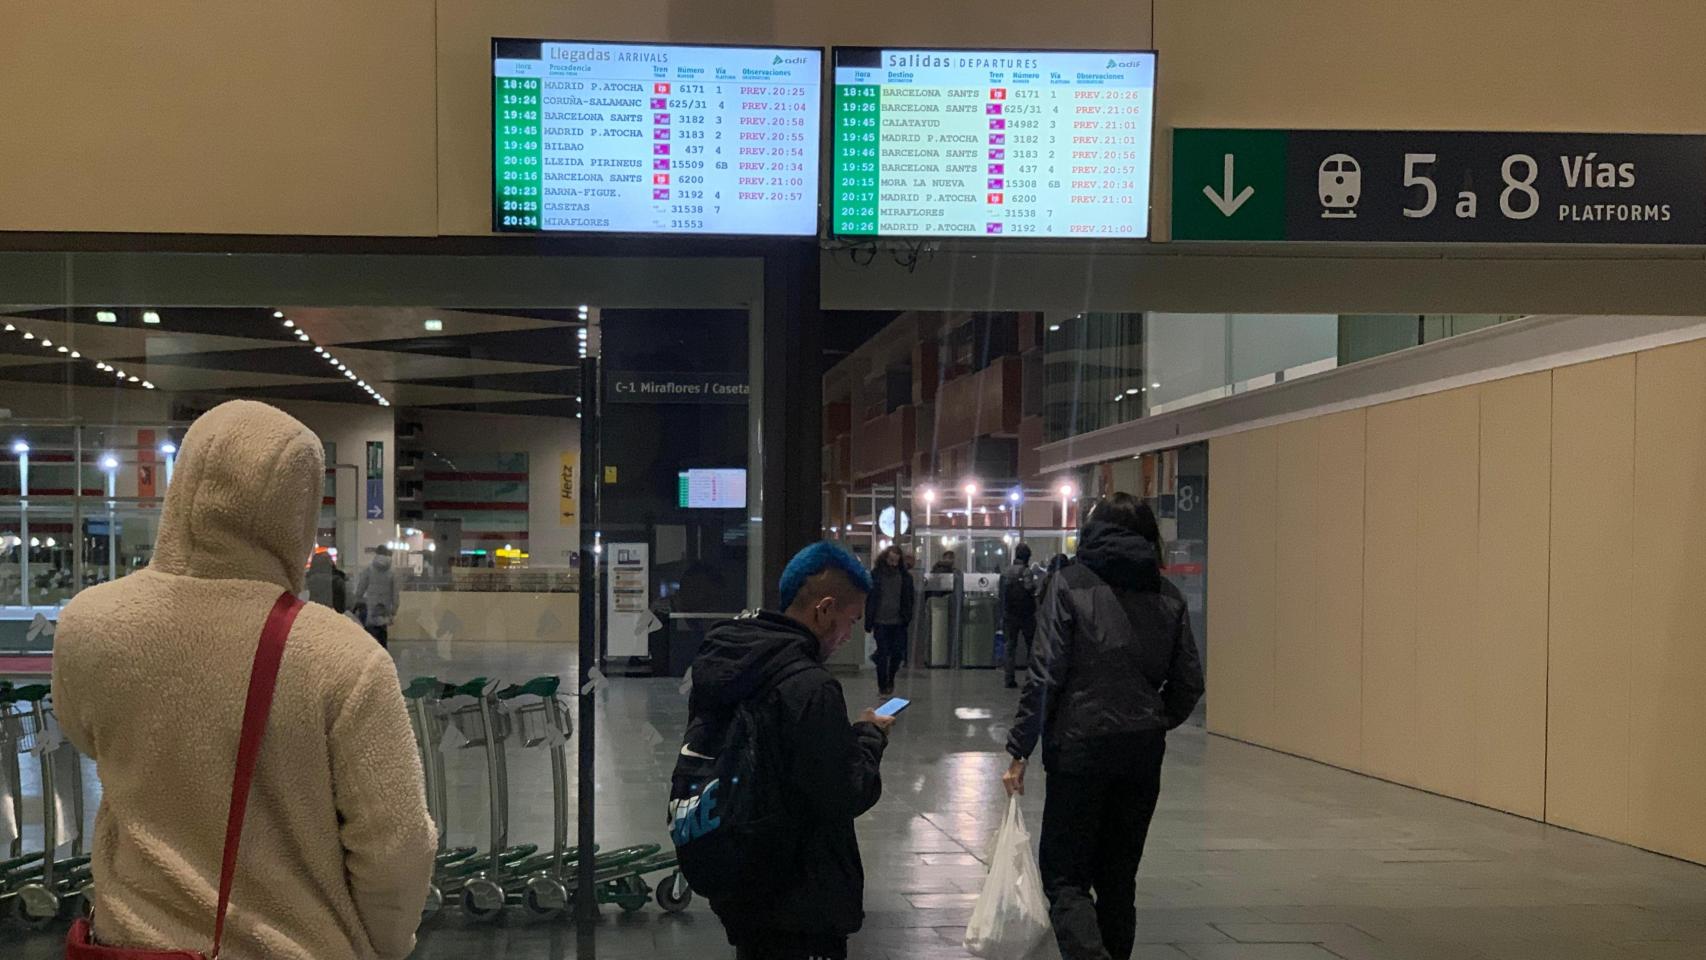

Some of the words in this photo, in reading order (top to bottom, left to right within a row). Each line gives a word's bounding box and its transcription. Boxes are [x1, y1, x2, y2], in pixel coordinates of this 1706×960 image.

[550, 48, 610, 62] Llegadas
[619, 52, 668, 62] ARRIVALS
[890, 55, 950, 67] Salidas
[960, 58, 1037, 68] DEPARTURES
[678, 66, 704, 74] Número
[742, 68, 791, 76] Observaciones
[504, 80, 537, 89] 18:40
[591, 83, 644, 92] P.ATOCHA
[680, 85, 704, 93] 6171
[717, 86, 722, 94] 1
[741, 87, 805, 96] PREV.20:25
[844, 88, 875, 96] 18:41
[883, 89, 941, 97] BARCELONA
[1075, 91, 1138, 99] PREV.20:26
[504, 96, 537, 104] 19:24
[544, 95, 642, 107] CORUÑA-SALAMANC
[669, 101, 706, 109] 625/31
[742, 103, 806, 111] PREV.21:04
[843, 103, 875, 112] 19:26
[882, 104, 939, 112] BARCELONA
[1053, 106, 1058, 114] 4
[1076, 106, 1139, 114] PREV.21:06
[504, 111, 537, 120] 19:42
[545, 112, 604, 121] BARCELONA
[610, 114, 643, 122] SANTS
[680, 116, 704, 124] 3182
[716, 116, 721, 124] 3
[740, 118, 804, 126] PREV.20:58
[843, 118, 875, 127] 19:45
[882, 119, 940, 127] CALATAYUD
[1051, 121, 1056, 129] 3
[1074, 121, 1136, 129] PREV.21:01
[504, 126, 537, 135] 19:45
[544, 128, 584, 136] MADRID
[591, 129, 643, 137] P.ATOCHA
[679, 131, 704, 139] 3183
[740, 133, 804, 141] PREV.20:55
[843, 133, 875, 142] 19:45
[882, 134, 920, 142] MADRID
[928, 135, 978, 143] P.ATOCHA
[1050, 136, 1055, 144] 3
[1073, 136, 1135, 144] PREV.21:01
[504, 142, 537, 150] 19:49
[544, 143, 584, 151] BILBAO
[685, 146, 704, 154] 437
[740, 148, 803, 156] PREV.20:54
[843, 148, 875, 157] 19:46
[882, 149, 939, 157] BARCELONA
[946, 150, 978, 158] SANTS
[1073, 151, 1135, 159] PREV.20:56
[504, 157, 537, 165] 20:05
[545, 158, 584, 166] LLEIDA
[590, 159, 642, 167] PIRINEUS
[672, 161, 704, 169] 15509
[739, 163, 803, 171] PREV.20:34
[842, 163, 874, 172] 19:52
[882, 164, 939, 172] BARCELONA
[945, 165, 977, 173] SANTS
[1072, 166, 1134, 174] PREV.20:57
[1559, 152, 1634, 188] Vías
[504, 172, 537, 180] 20:16
[544, 173, 604, 182] BARCELONA
[610, 174, 642, 182] SANTS
[842, 178, 874, 187] 20:15
[914, 179, 926, 187] LA
[933, 179, 964, 187] NUEVA
[1006, 180, 1036, 188] 15308
[1072, 181, 1134, 189] PREV.20:34
[1403, 153, 1437, 218] 5
[1456, 190, 1477, 218] a
[1500, 154, 1539, 219] 8
[504, 186, 537, 195] 20:23
[544, 188, 621, 197] BARNA-FIGUE.
[678, 191, 703, 199] 3192
[842, 193, 874, 202] 20:17
[926, 194, 977, 202] P.ATOCHA
[1012, 195, 1036, 203] 6200
[1071, 196, 1133, 204] PREV.21:01
[504, 202, 537, 210] 20:25
[544, 203, 590, 211] CASETAS
[715, 206, 720, 214] 7
[842, 208, 874, 217] 20:26
[1005, 210, 1036, 218] 31538
[1047, 210, 1052, 218] 7
[1559, 205, 1671, 222] PLATFORMS
[504, 216, 537, 225] 20:34
[544, 218, 609, 226] MIRAFLORES
[842, 223, 874, 232] 20:26
[925, 224, 976, 232] P.ATOCHA
[1070, 225, 1132, 233] PREV.21:00
[616, 382, 636, 393] C-1
[640, 382, 700, 394] Miraflores
[561, 465, 573, 499] Hertz
